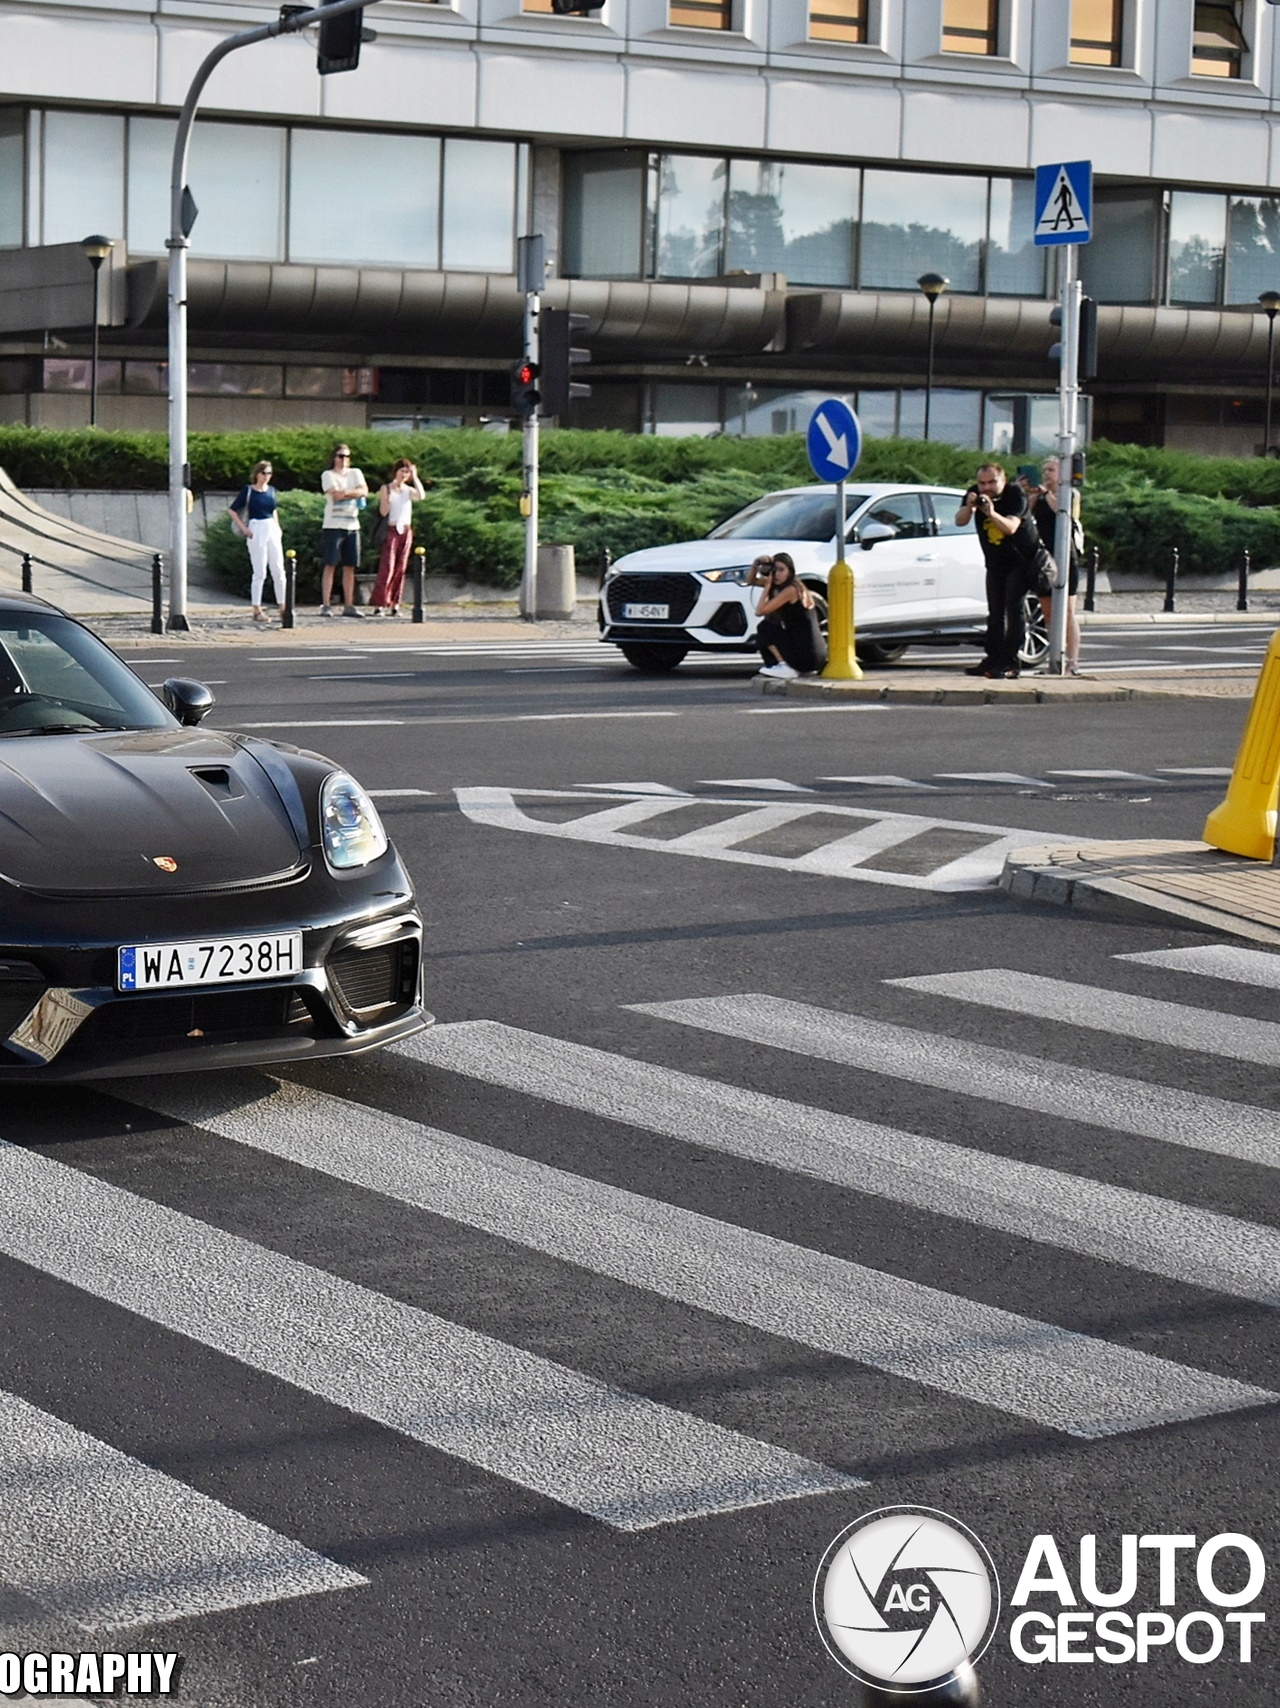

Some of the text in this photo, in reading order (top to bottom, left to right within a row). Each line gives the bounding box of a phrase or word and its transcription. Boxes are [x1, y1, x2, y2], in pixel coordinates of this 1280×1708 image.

[143, 938, 293, 983] WA 7238H
[122, 973, 135, 983] PL
